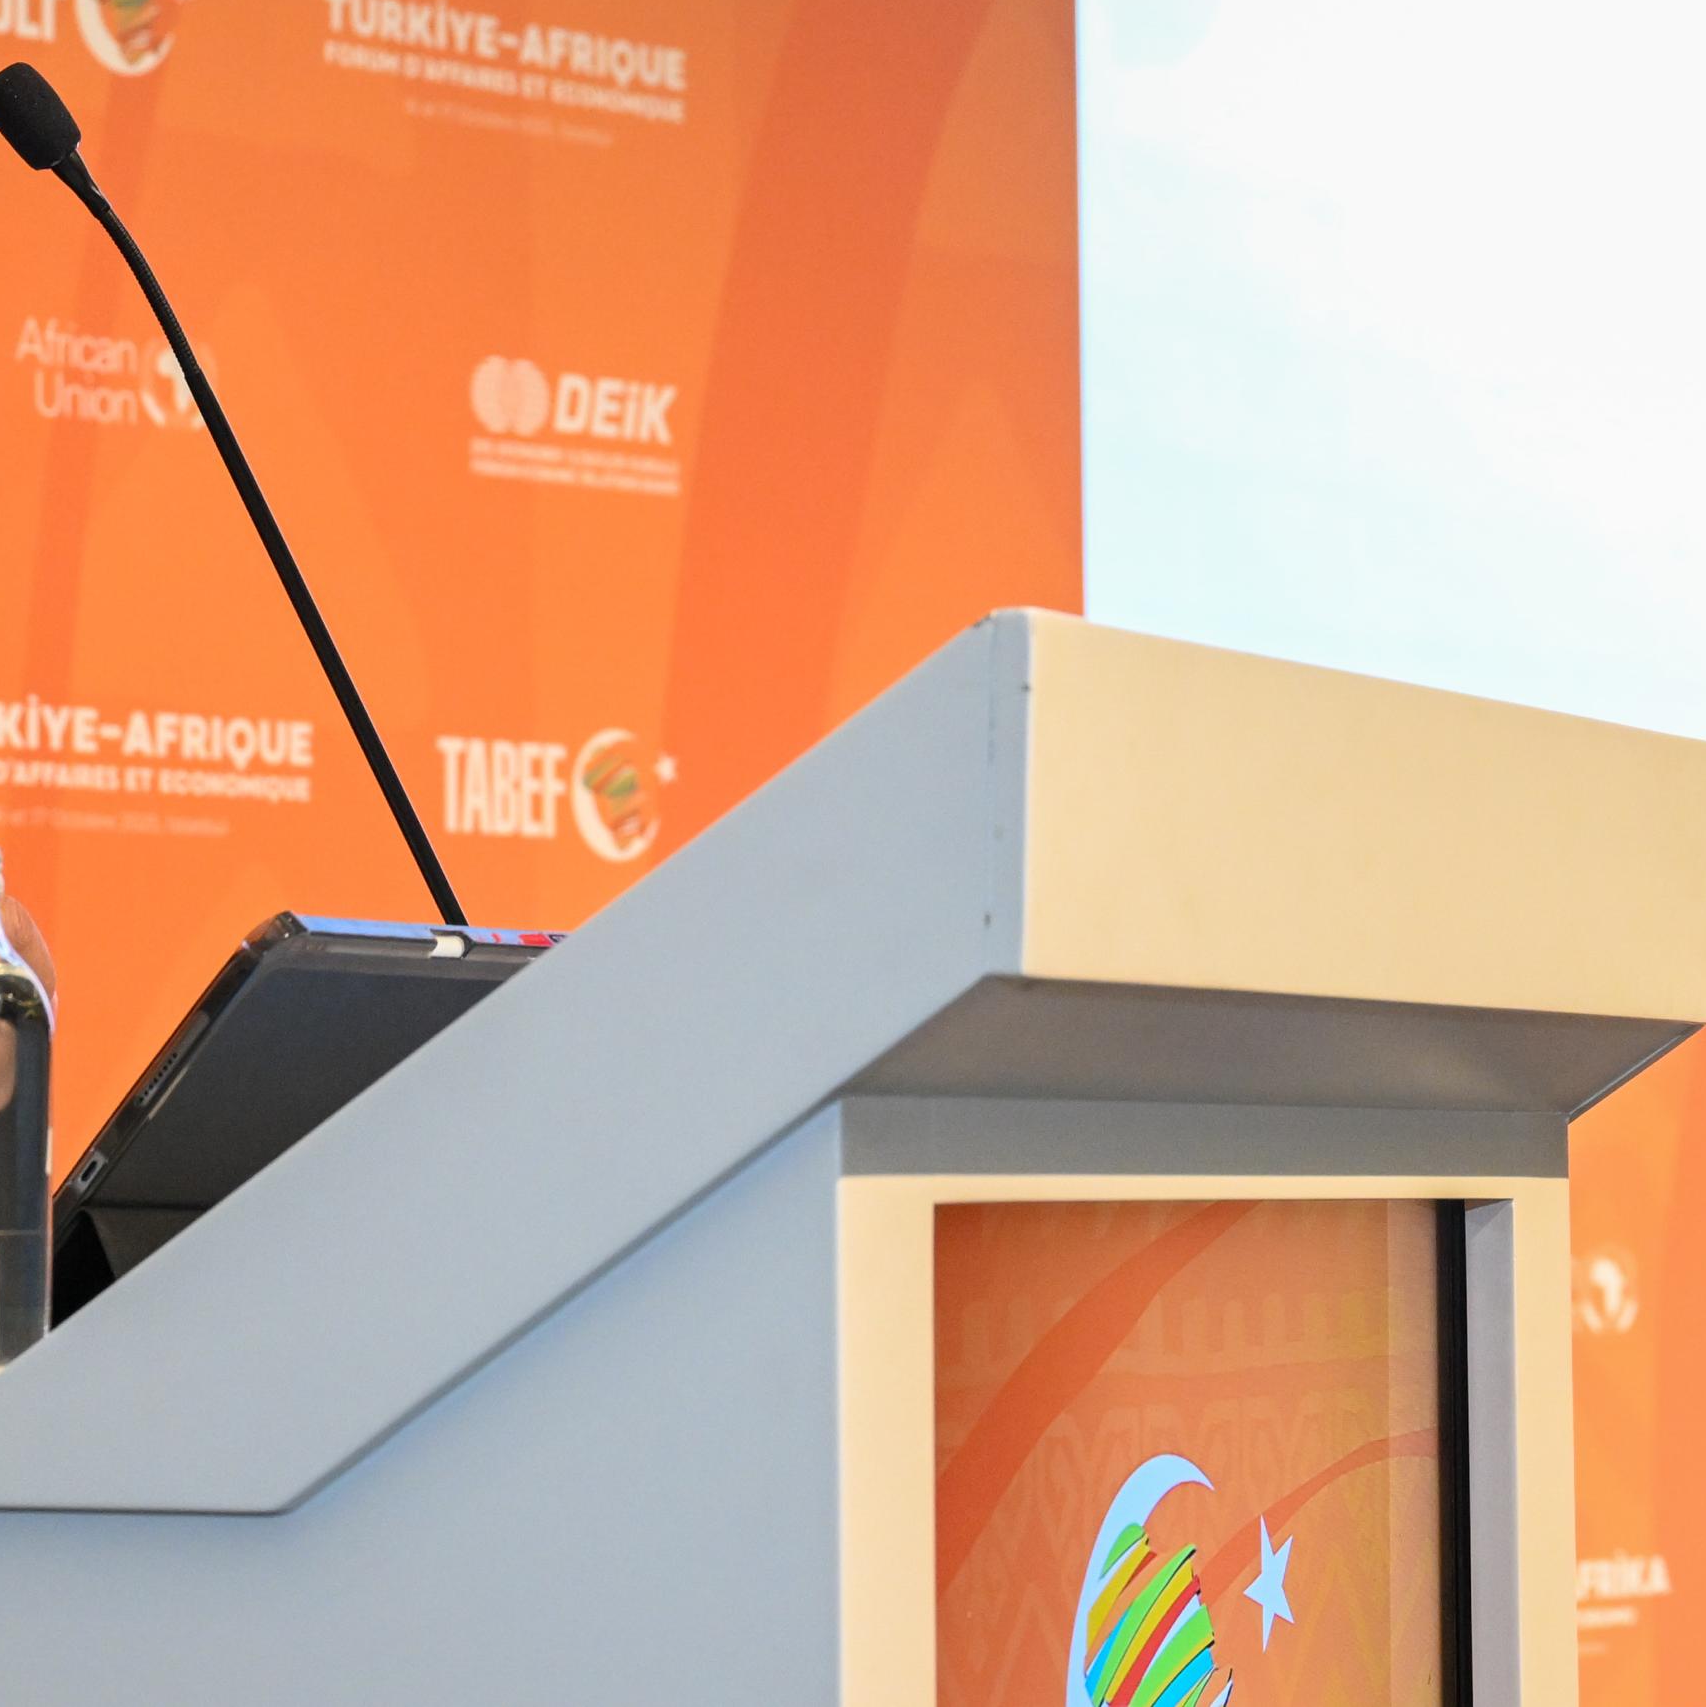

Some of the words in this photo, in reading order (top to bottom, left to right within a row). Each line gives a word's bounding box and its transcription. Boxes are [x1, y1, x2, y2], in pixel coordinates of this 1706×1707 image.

[14, 315, 139, 374] African
[34, 366, 139, 425] Union
[123, 765, 154, 795] ET
[434, 734, 568, 839] TABEF
